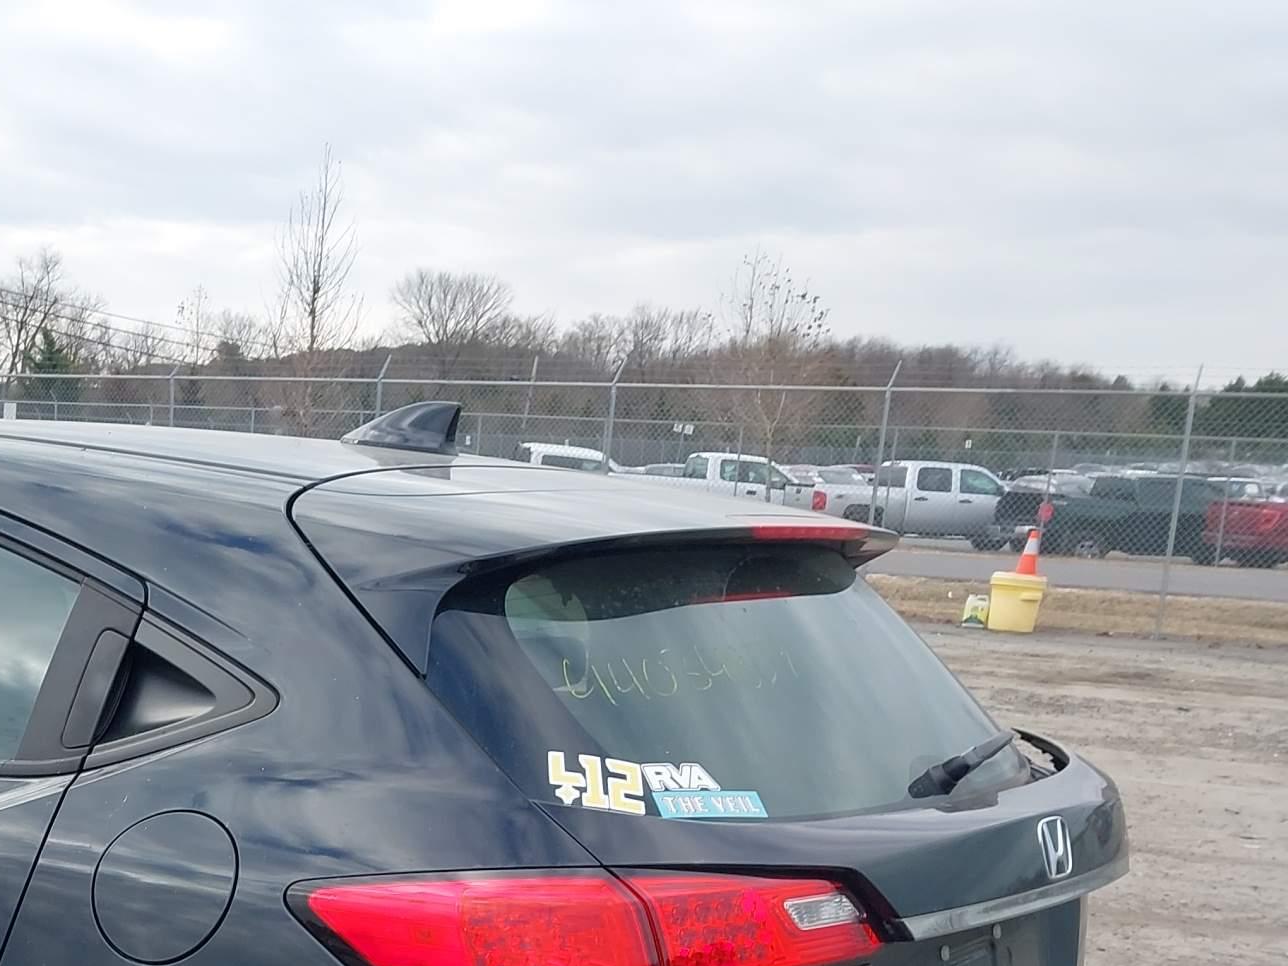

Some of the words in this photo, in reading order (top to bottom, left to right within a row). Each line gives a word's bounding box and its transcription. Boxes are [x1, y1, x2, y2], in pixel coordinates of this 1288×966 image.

[641, 762, 721, 791] RVA
[662, 795, 709, 814] THE
[710, 795, 761, 814] VEIL
